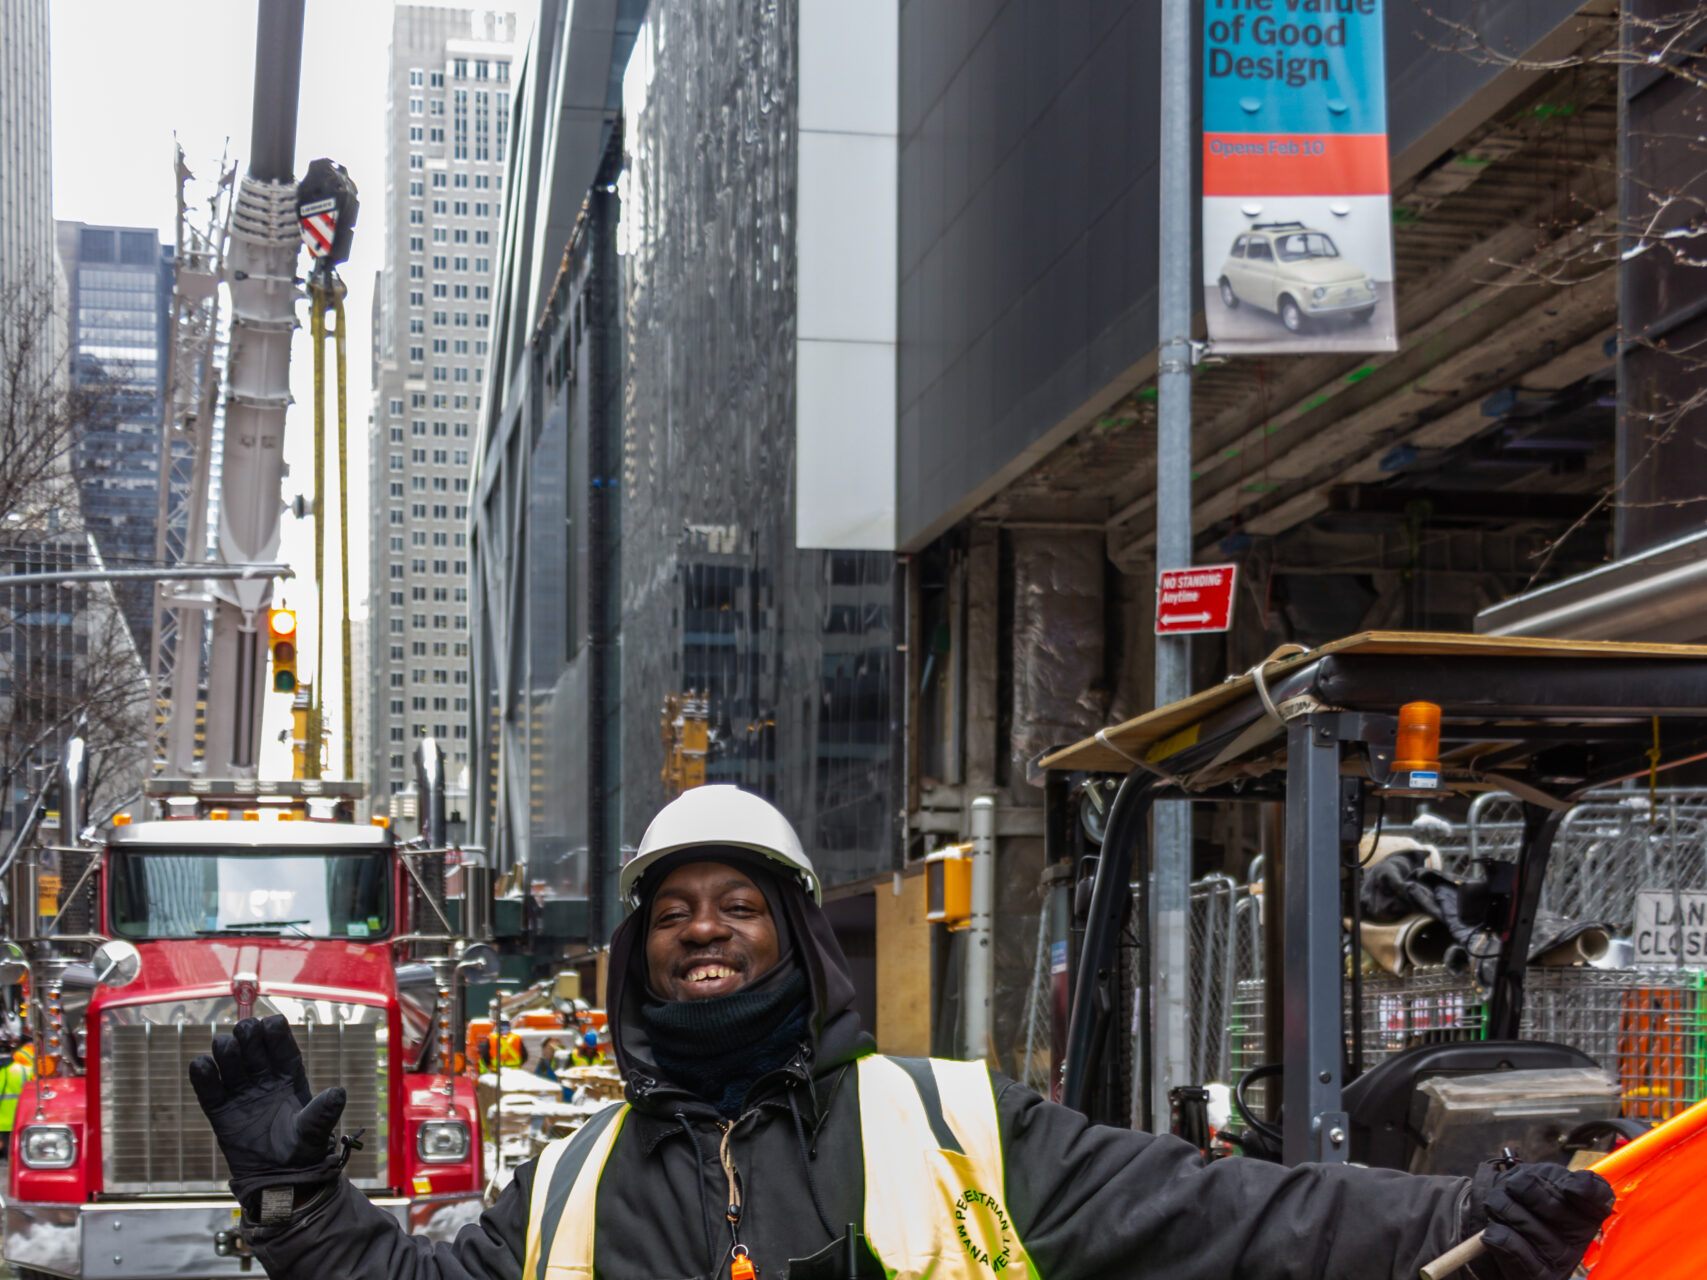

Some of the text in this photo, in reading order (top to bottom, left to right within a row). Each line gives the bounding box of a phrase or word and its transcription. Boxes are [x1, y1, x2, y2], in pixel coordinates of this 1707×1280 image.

[1209, 14, 1346, 47] of Good
[1209, 48, 1329, 87] Design
[1210, 139, 1324, 158] Opens Feb 10
[1163, 574, 1222, 589] NO STANDING
[955, 1190, 1009, 1230] PEESTRIAN
[957, 1224, 1011, 1272] MANAMENT
